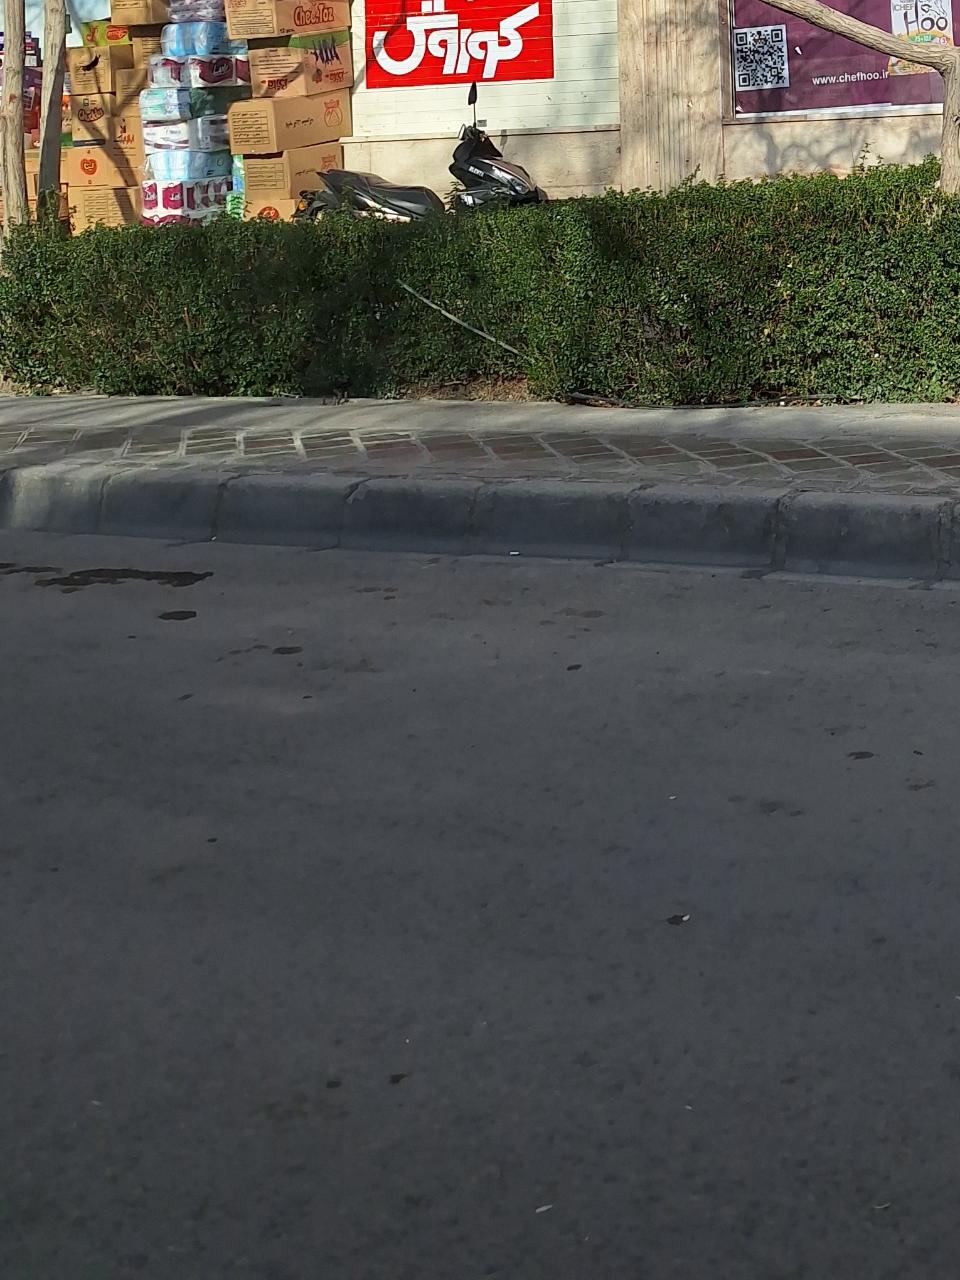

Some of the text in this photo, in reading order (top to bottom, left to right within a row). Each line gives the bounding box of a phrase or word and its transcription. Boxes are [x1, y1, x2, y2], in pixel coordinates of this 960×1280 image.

[894, 3, 914, 11] CHEF
[903, 0, 948, 36] Hoo
[811, 70, 889, 86] www.chefhoo.ir
